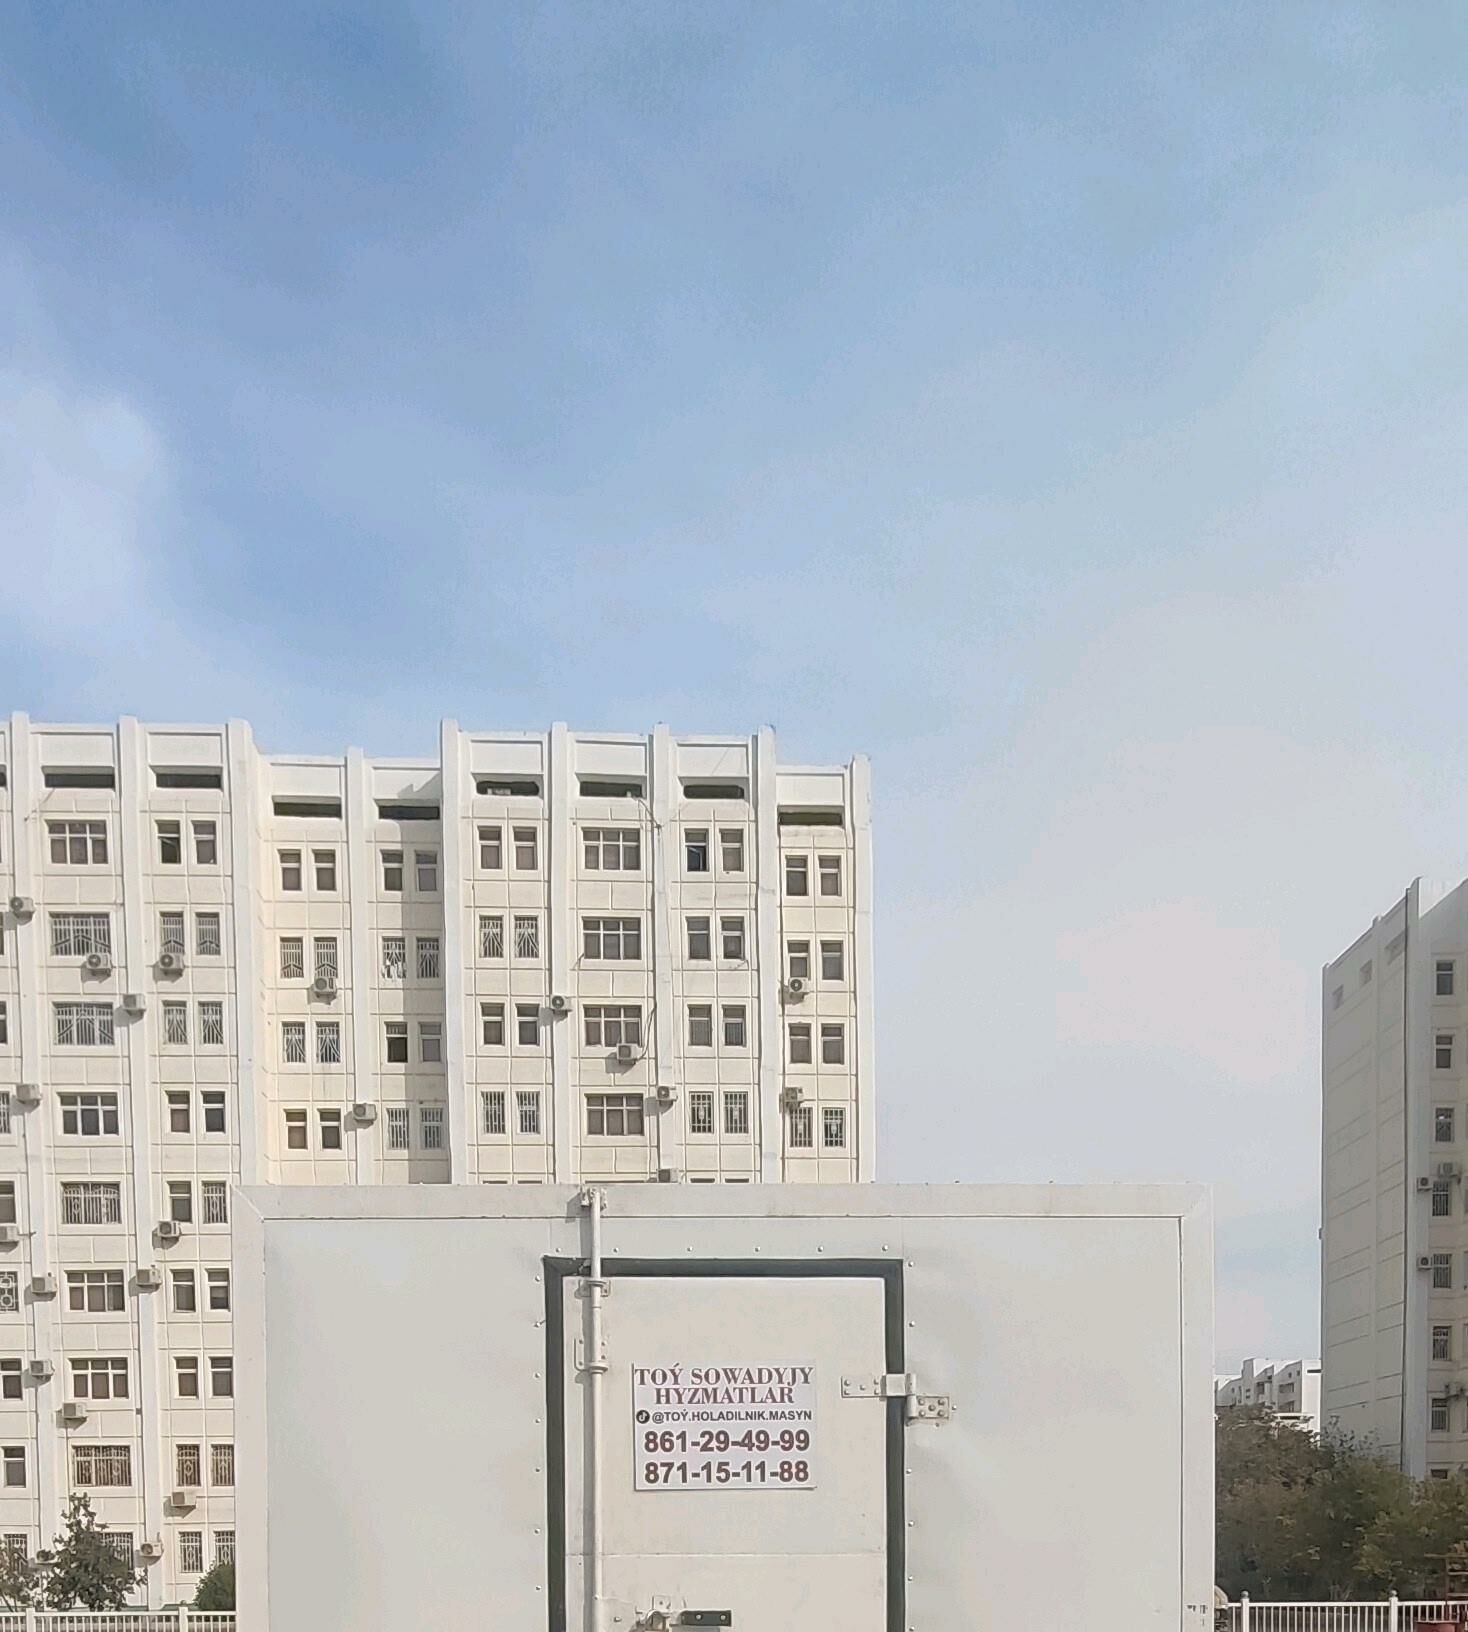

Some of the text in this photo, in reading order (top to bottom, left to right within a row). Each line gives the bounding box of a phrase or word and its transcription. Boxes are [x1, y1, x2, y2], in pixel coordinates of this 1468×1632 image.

[635, 1362, 813, 1386] TOÝ SOWADYJY
[655, 1387, 794, 1404] HYZMATLAR
[644, 1430, 810, 1453] 861-29-49-99
[644, 1461, 809, 1484] 871-15-11-88
